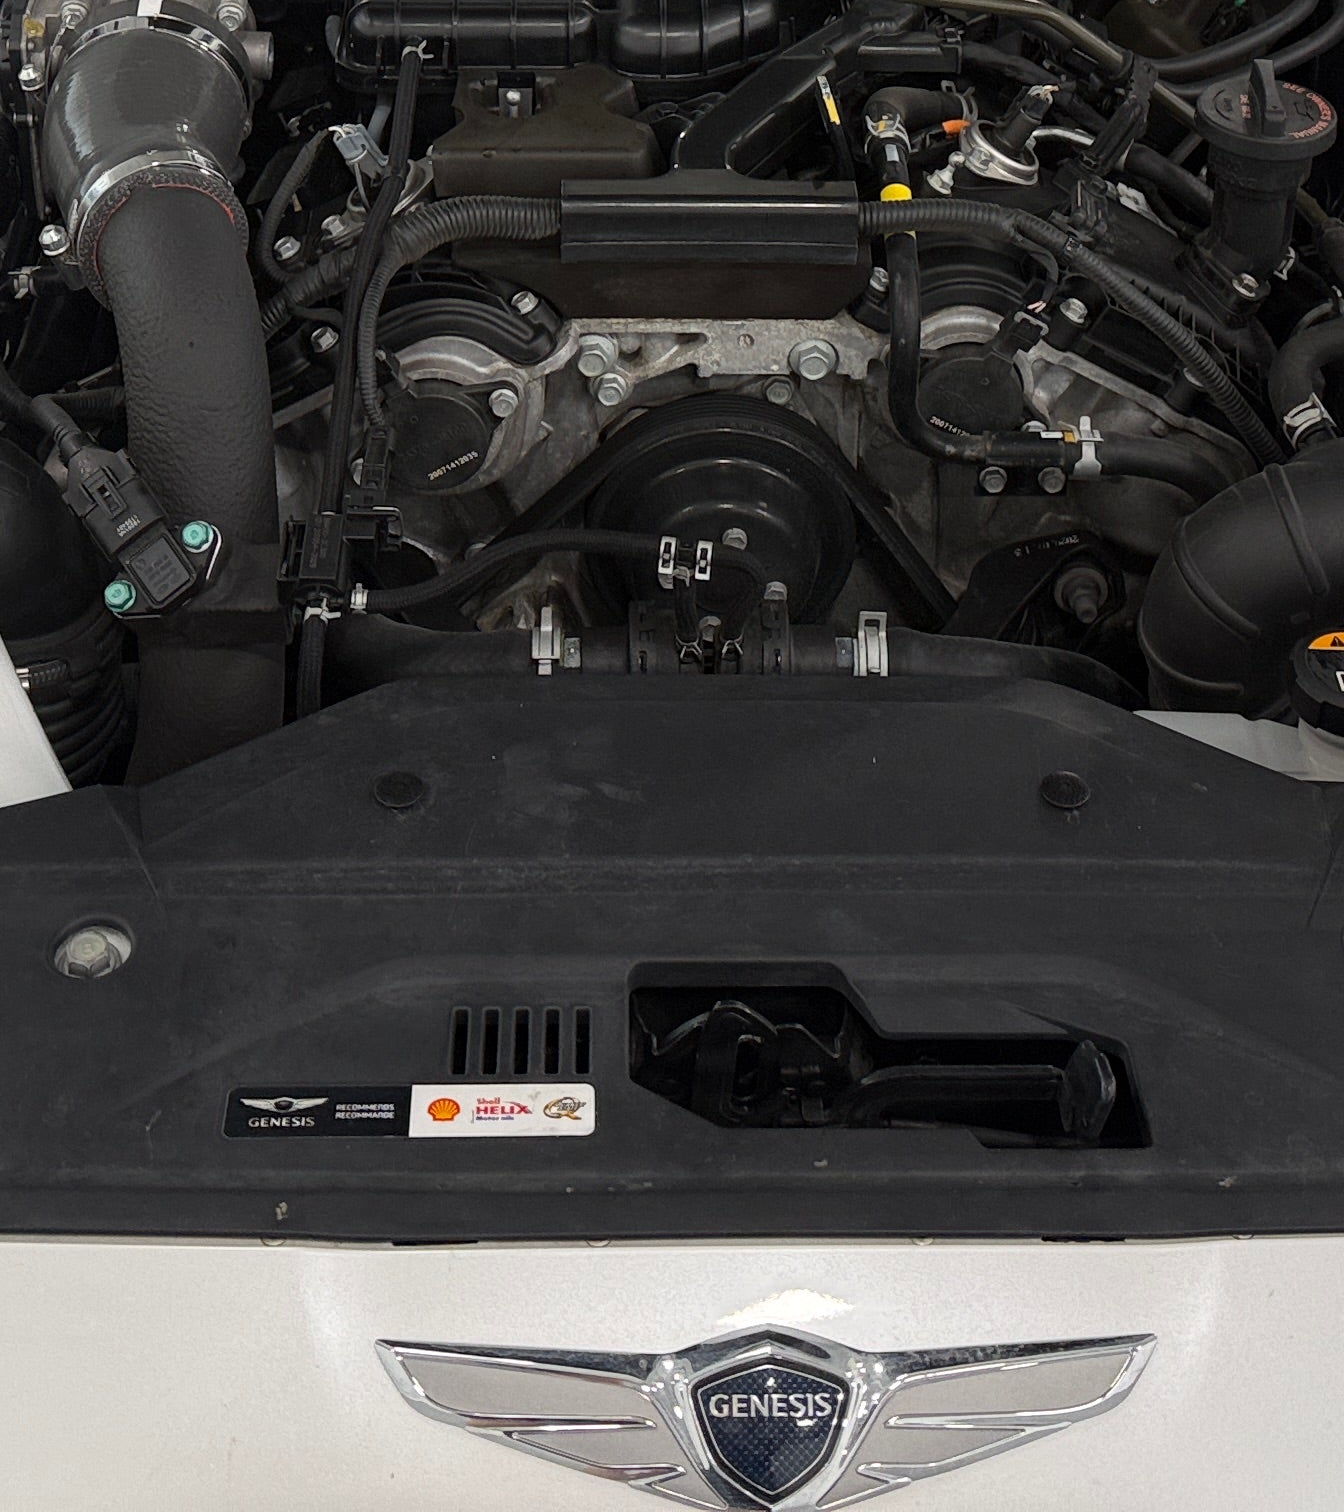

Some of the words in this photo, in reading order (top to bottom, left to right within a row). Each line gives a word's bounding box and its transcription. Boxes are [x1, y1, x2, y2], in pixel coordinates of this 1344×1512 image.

[477, 1097, 501, 1105] Shell
[476, 1104, 532, 1115] HELIX
[247, 1116, 316, 1128] GENESIS
[708, 1392, 832, 1419] GENESIS
